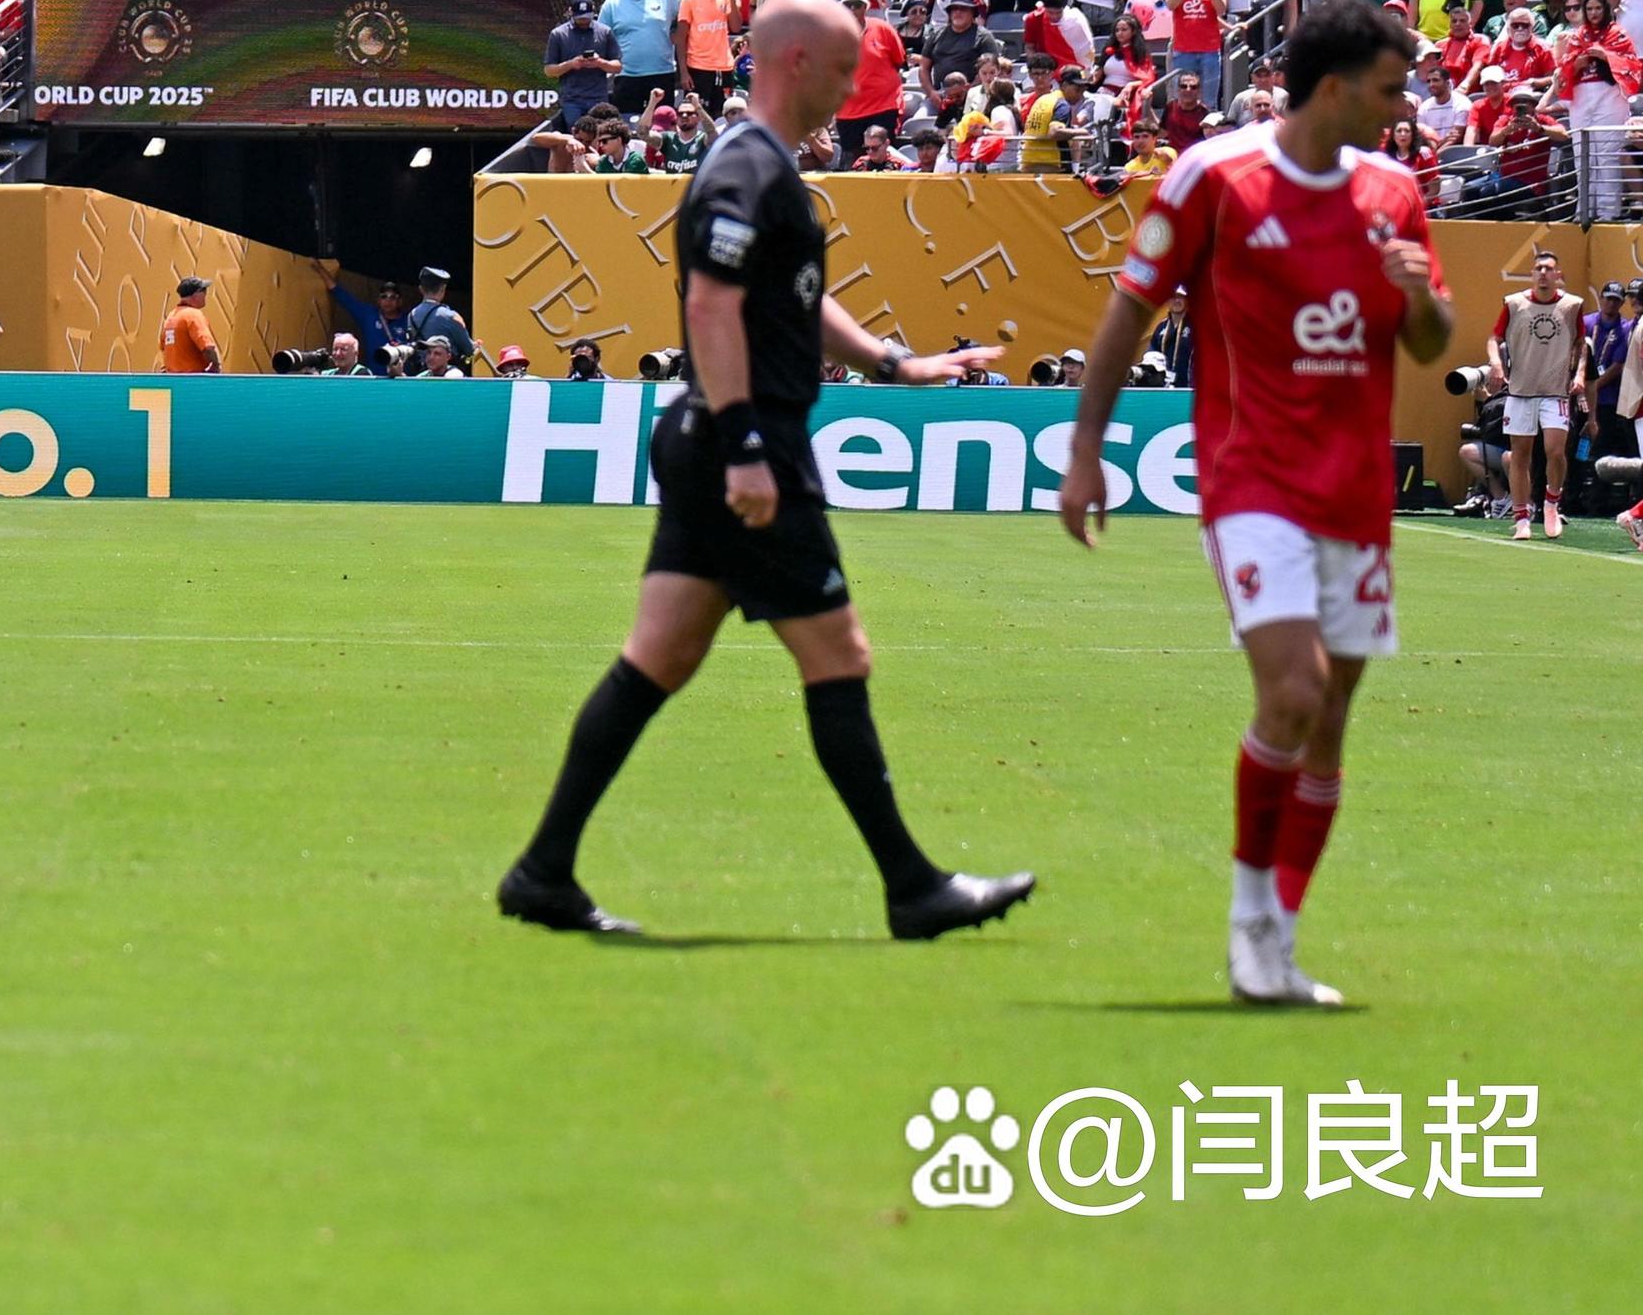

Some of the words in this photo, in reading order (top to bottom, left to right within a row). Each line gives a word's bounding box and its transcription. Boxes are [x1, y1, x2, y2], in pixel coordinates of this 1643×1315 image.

[99, 86, 143, 106] CUP
[310, 87, 360, 108] FIFA
[362, 87, 423, 108] CLUB
[425, 87, 508, 108] WORLD
[512, 90, 560, 110] CUP
[1292, 288, 1367, 355] e&
[129, 388, 171, 498] 1
